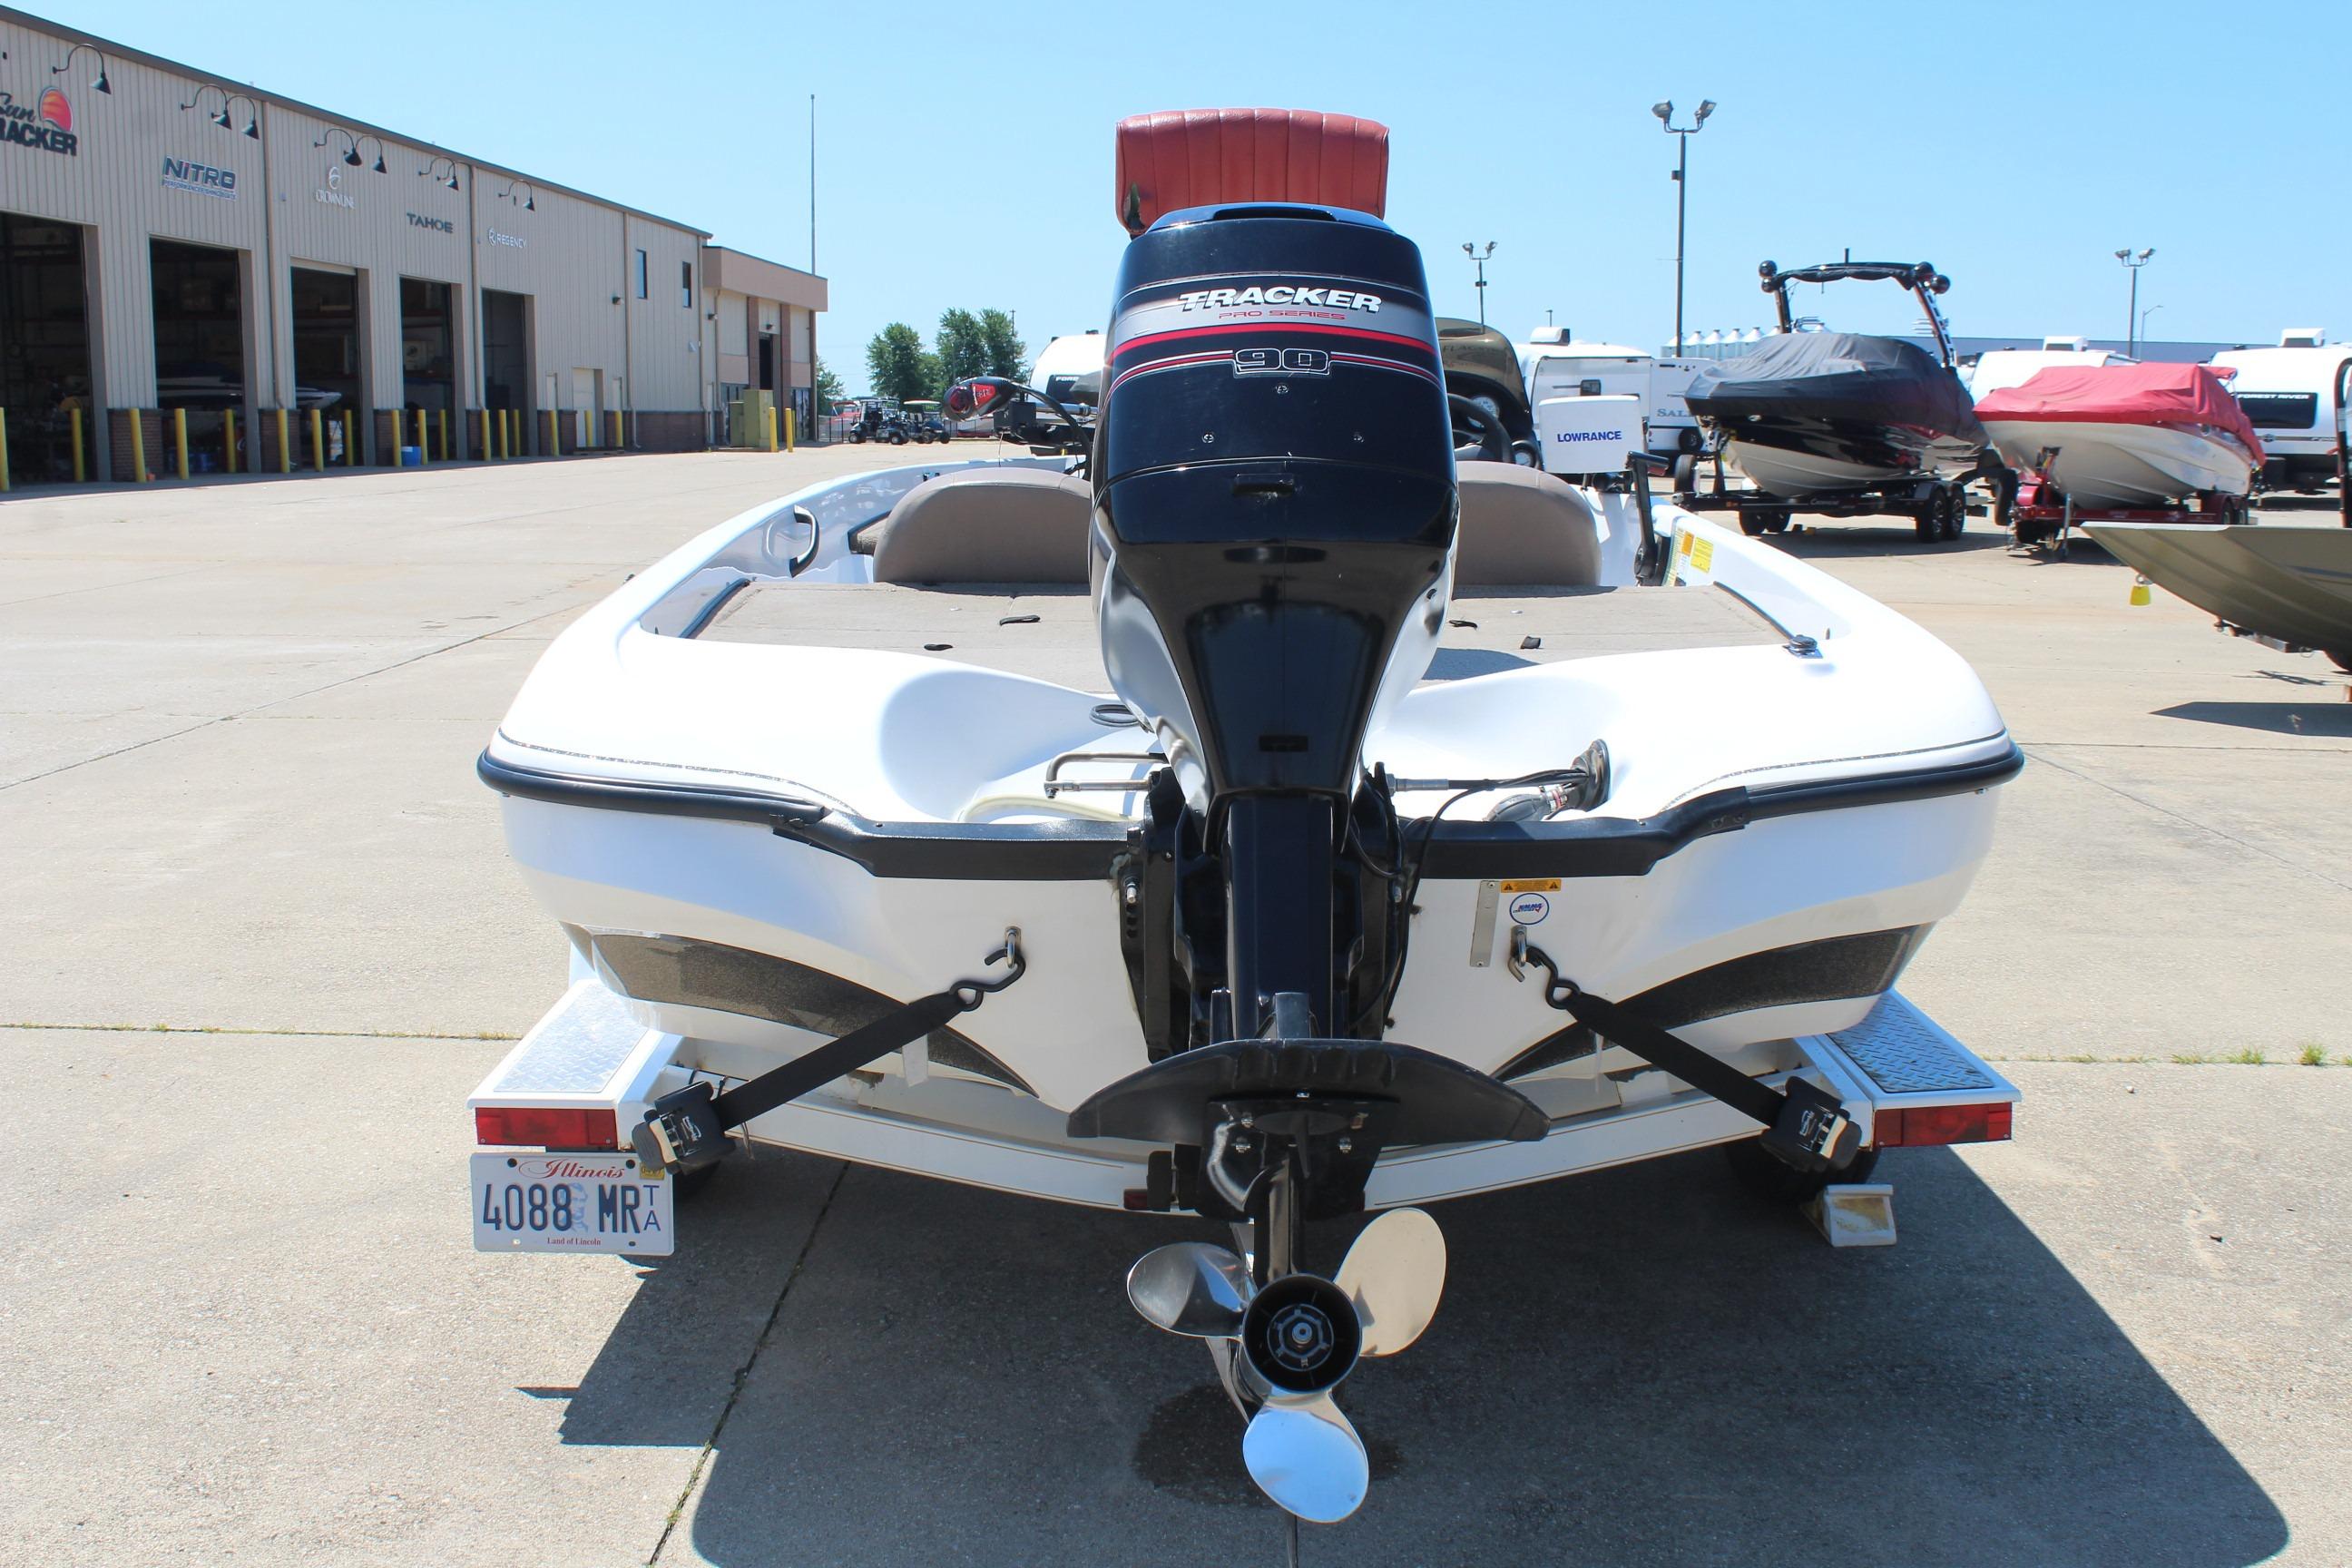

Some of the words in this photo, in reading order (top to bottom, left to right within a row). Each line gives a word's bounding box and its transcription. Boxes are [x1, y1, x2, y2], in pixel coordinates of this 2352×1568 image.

[407, 212, 454, 234] TAHOE
[496, 233, 526, 249] REGENCY
[1179, 286, 1382, 313] TRACKER
[1219, 310, 1262, 319] PRO
[1269, 309, 1346, 320] SERIES
[1235, 348, 1328, 372] 90
[1557, 430, 1622, 443] LOWRANCE
[518, 1158, 625, 1180] Illinois
[483, 1182, 572, 1231] 4088
[597, 1183, 641, 1234] MR
[547, 1237, 565, 1246] Land
[566, 1238, 573, 1246] of
[575, 1238, 602, 1247] Lincoln
